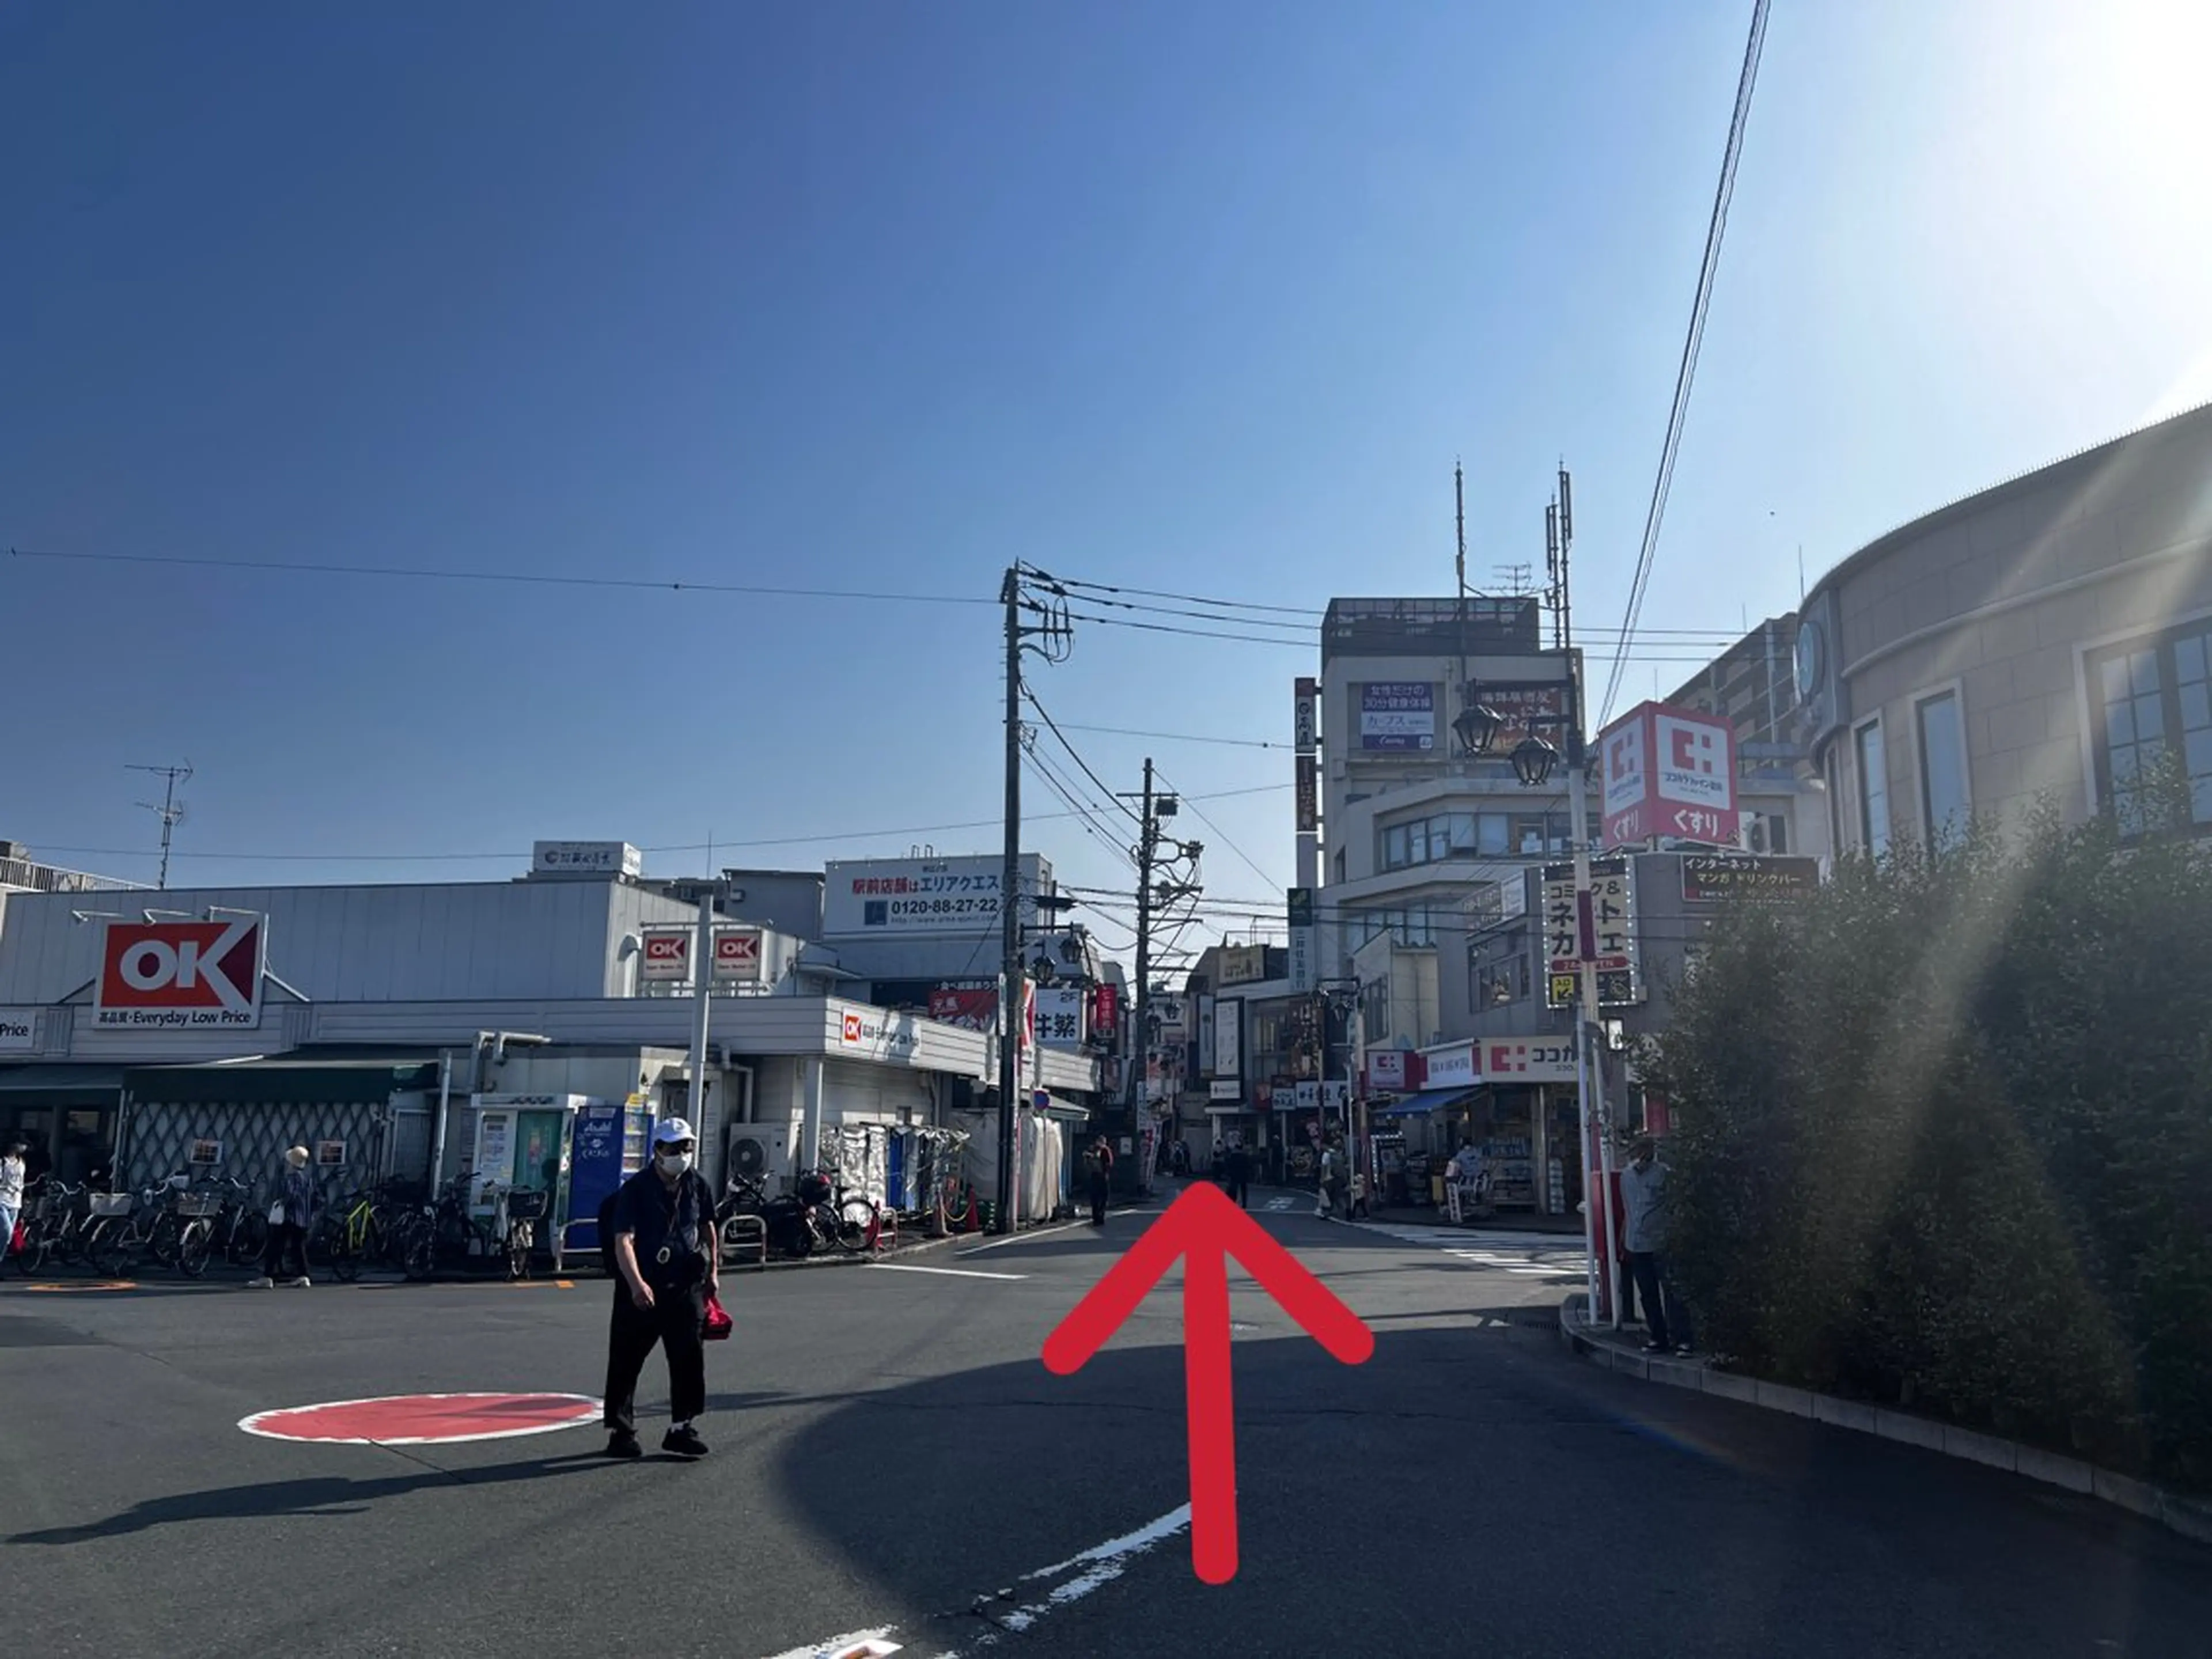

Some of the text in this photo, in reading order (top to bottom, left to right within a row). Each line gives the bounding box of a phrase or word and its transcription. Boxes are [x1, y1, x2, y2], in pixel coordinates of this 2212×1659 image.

[1613, 809, 1639, 840] くすり
[1673, 809, 1718, 837] くすり
[1685, 858, 1761, 870] インターネット
[853, 874, 1000, 894] 駅前店舗はエリアクエス
[1697, 873, 1730, 883] マンガ
[1550, 880, 1620, 899] コミク&
[1550, 899, 1621, 927] ネト
[650, 938, 685, 959] OK
[722, 938, 757, 958] OK
[120, 922, 259, 1006] OK
[192, 1010, 218, 1023] Low
[222, 1010, 251, 1023] Price
[0, 1024, 28, 1036] Price
